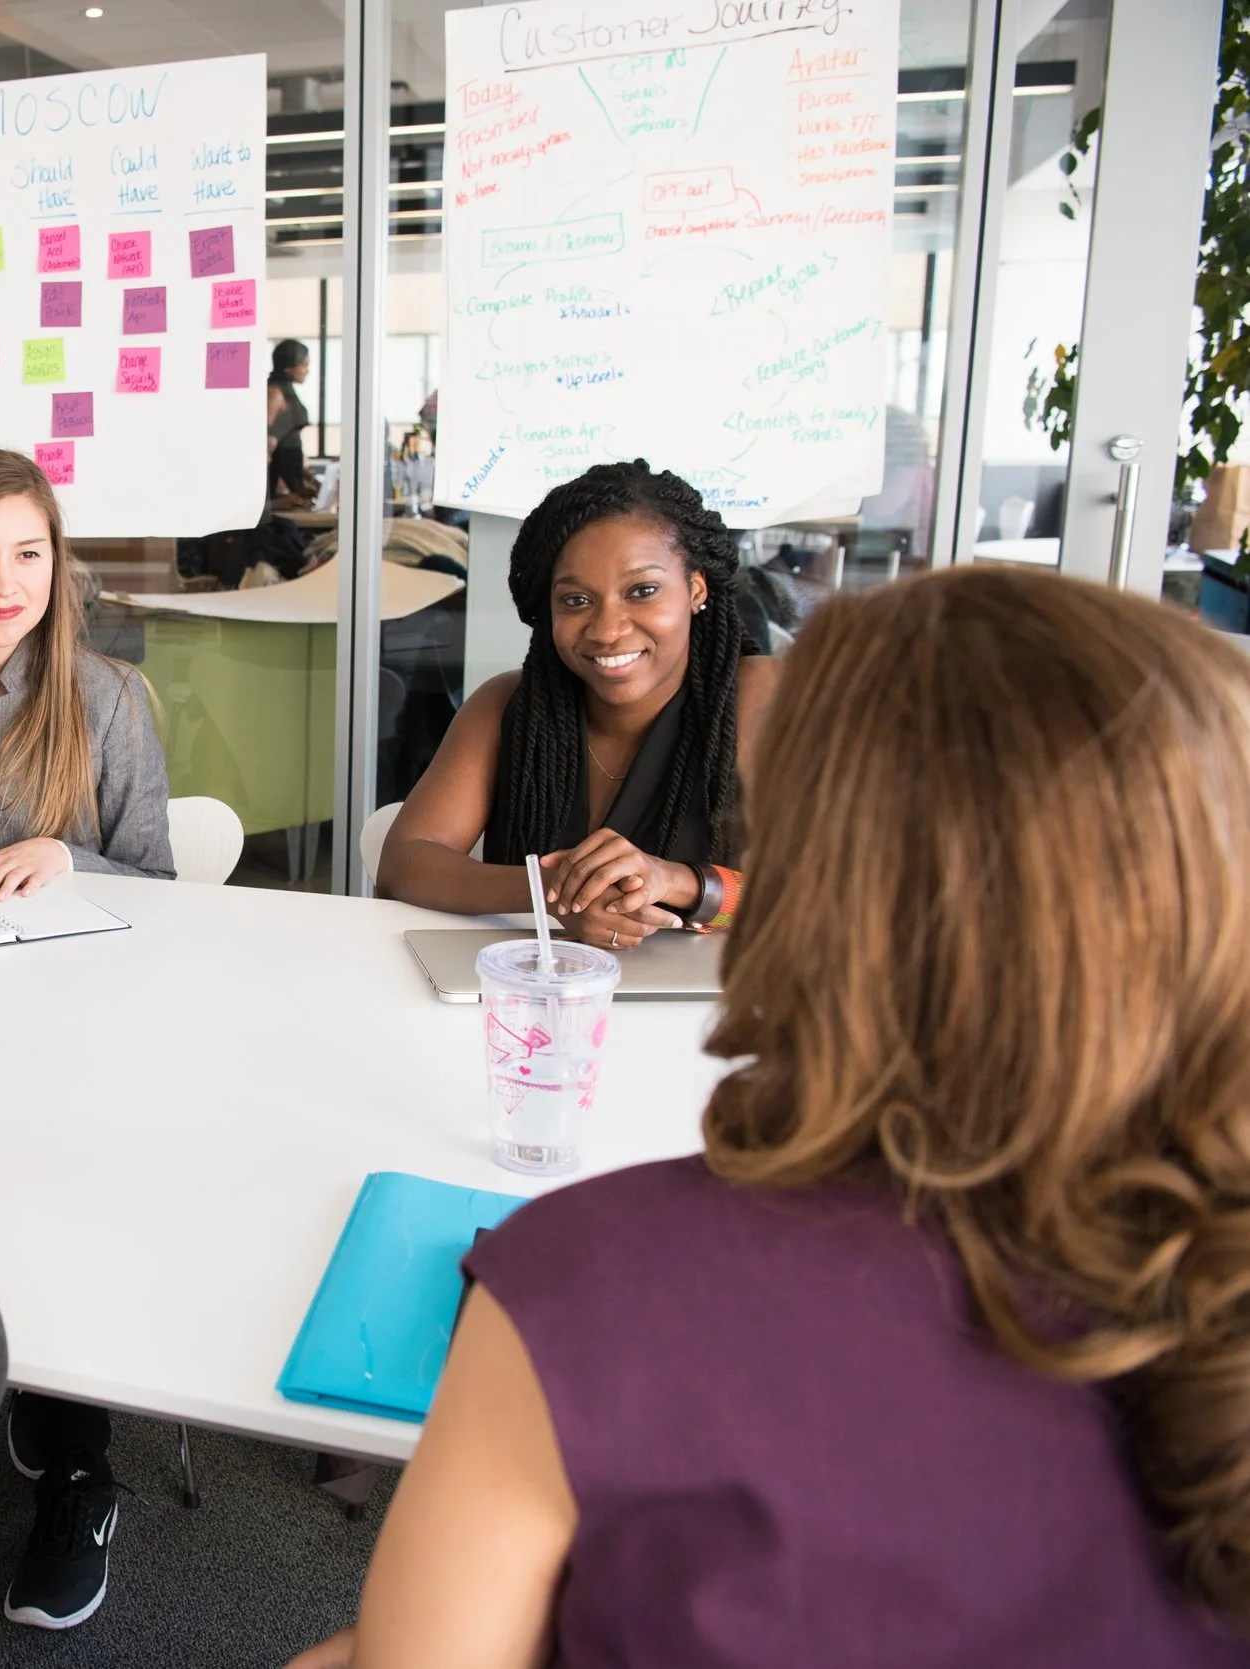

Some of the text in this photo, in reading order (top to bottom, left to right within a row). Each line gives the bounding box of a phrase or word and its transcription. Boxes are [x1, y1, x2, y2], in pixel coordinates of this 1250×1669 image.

[500, 7, 684, 65] Customer
[788, 47, 869, 79] Avatar
[457, 77, 518, 112] Today
[10, 154, 73, 190] Should
[110, 143, 158, 177] Could
[37, 185, 76, 212] Have
[118, 180, 160, 207] Have
[192, 178, 238, 204] Have
